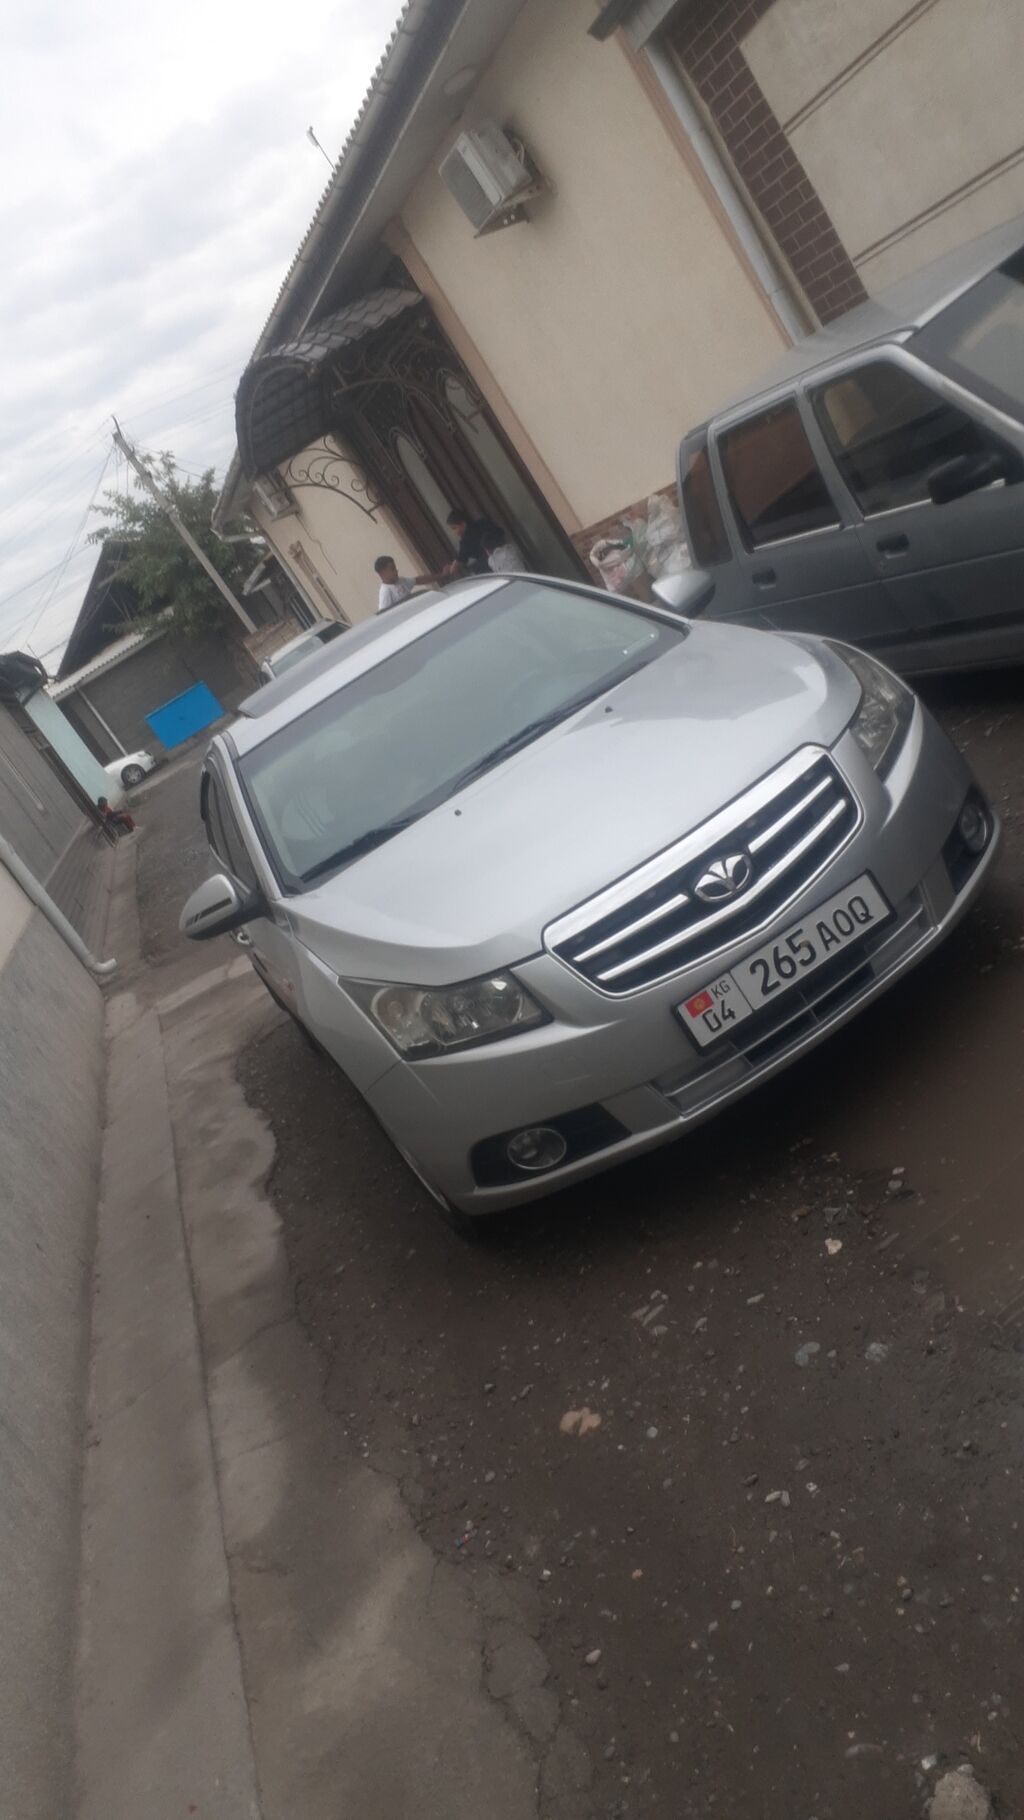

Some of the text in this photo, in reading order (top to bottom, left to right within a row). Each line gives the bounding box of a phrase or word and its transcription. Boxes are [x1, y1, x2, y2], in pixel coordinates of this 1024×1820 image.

[749, 896, 874, 996] 265 AOQ
[711, 980, 731, 999] KG
[702, 1000, 736, 1033] 04
